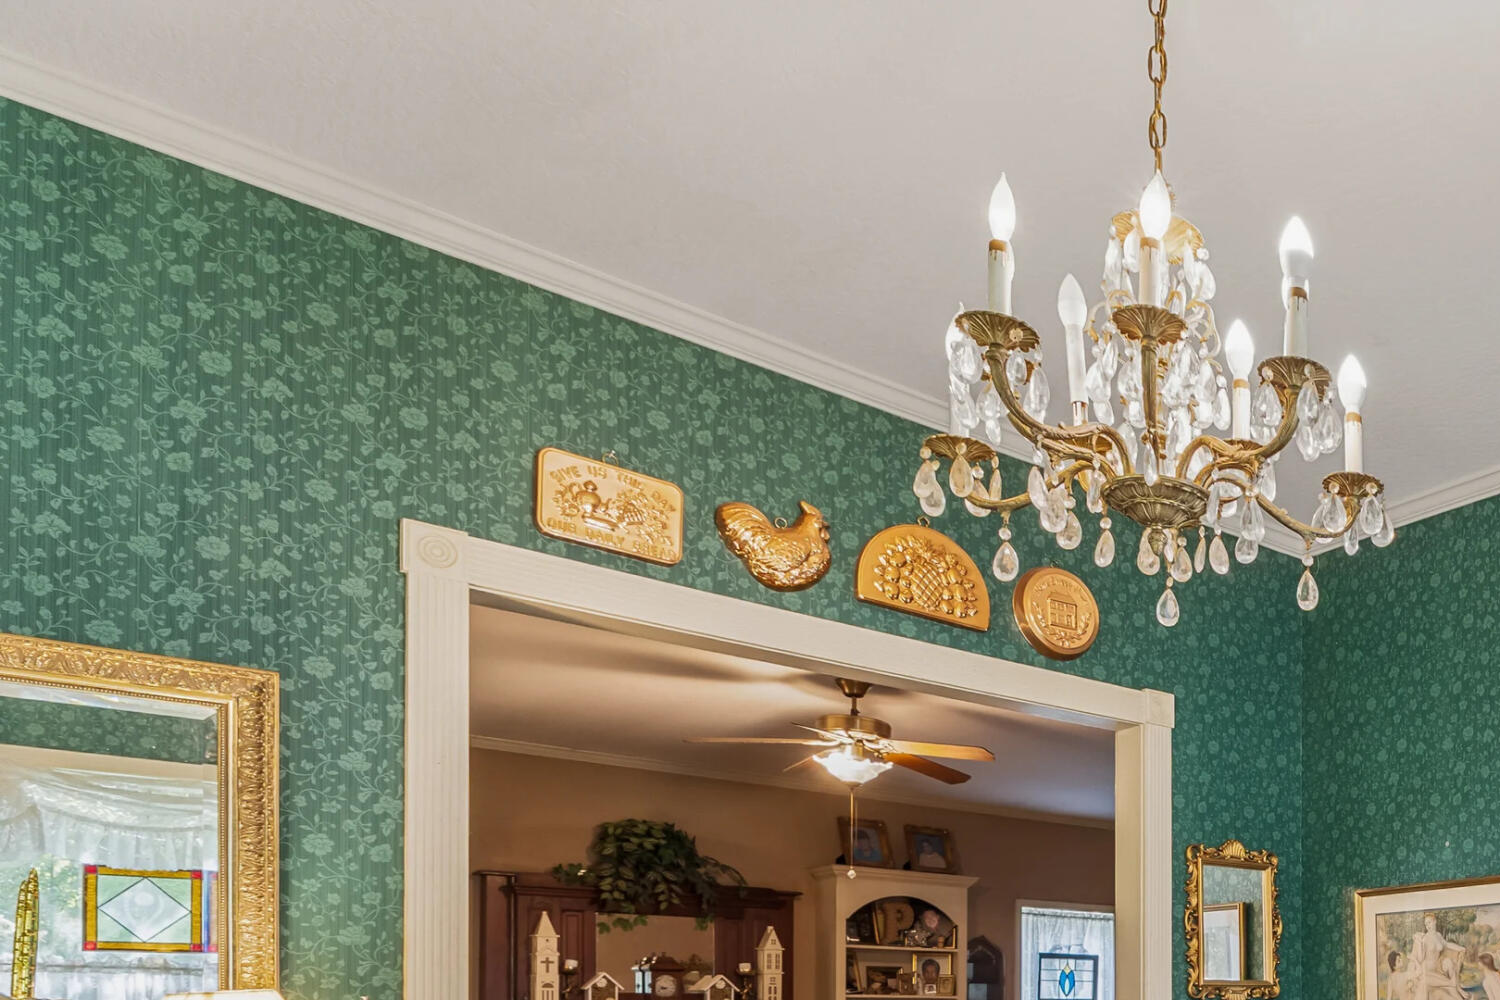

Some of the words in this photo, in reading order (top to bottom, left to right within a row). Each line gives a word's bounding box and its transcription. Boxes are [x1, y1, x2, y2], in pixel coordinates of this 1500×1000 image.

[550, 465, 582, 482] GIVE
[587, 465, 608, 480] US
[546, 516, 578, 534] OUR
[584, 527, 626, 546] DAILY
